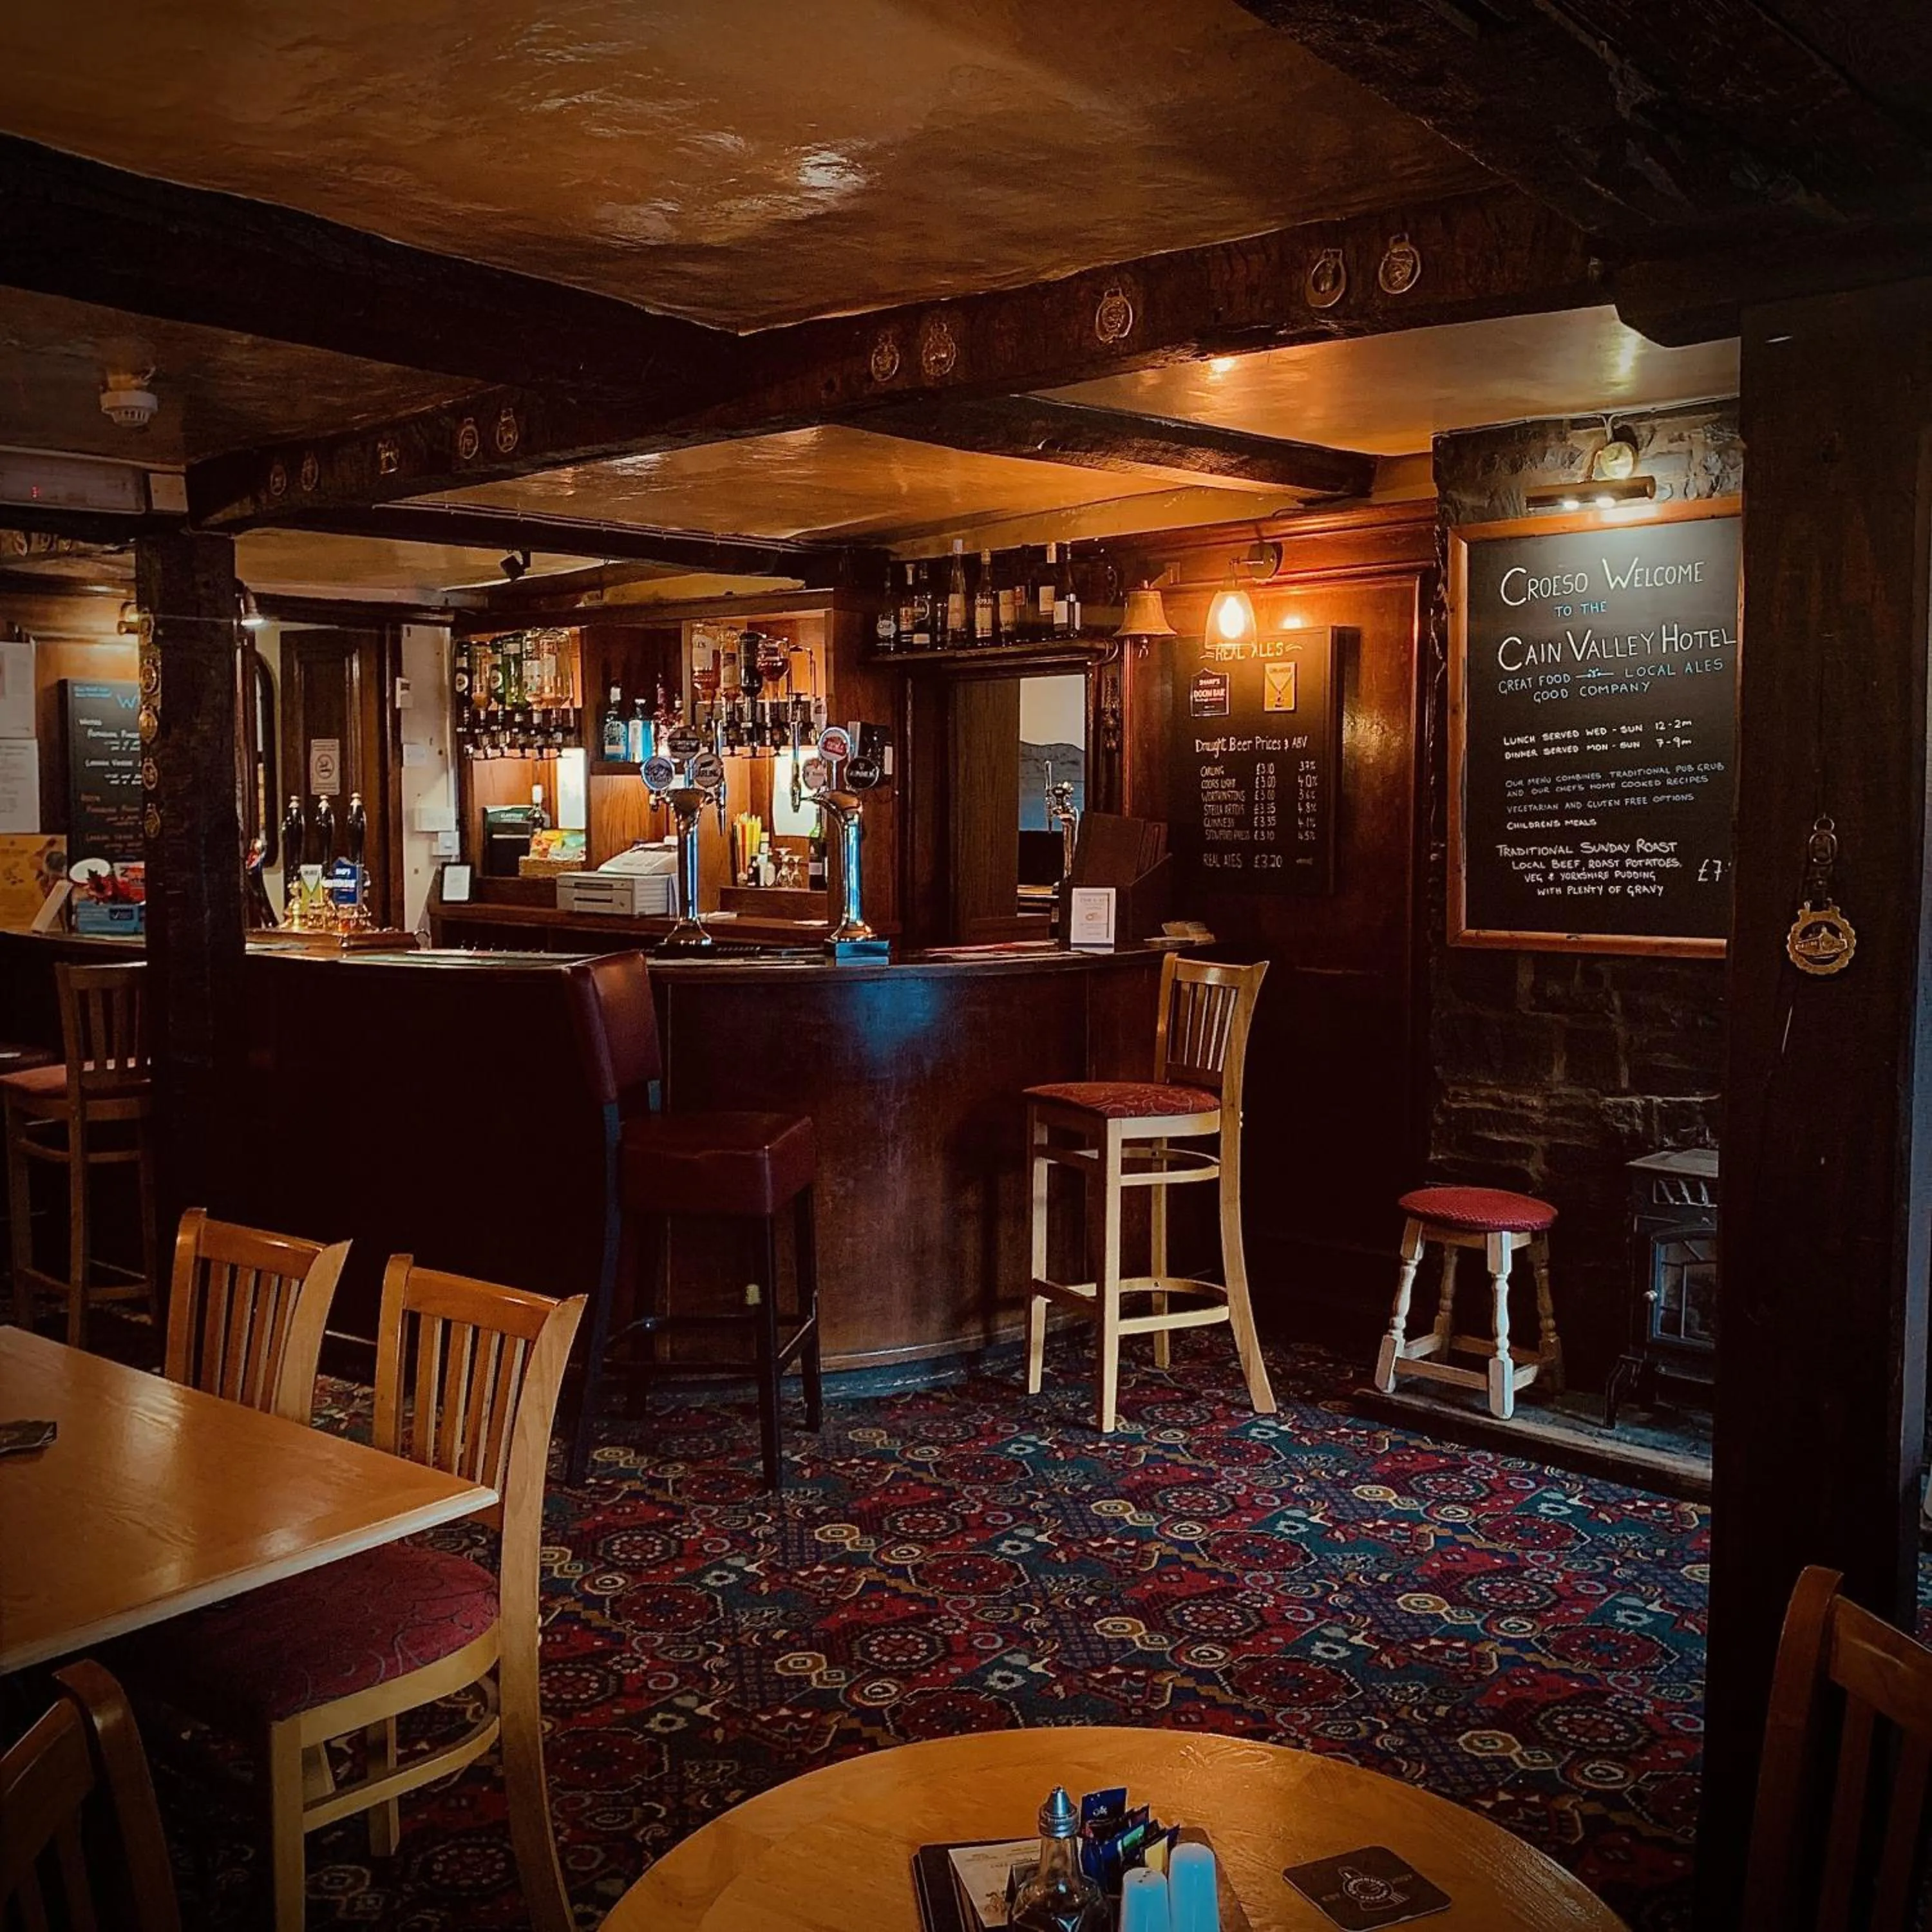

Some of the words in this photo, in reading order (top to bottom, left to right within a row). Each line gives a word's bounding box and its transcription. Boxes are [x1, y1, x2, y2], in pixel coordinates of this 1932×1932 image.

[1501, 567, 1588, 606] CROESO
[1602, 557, 1704, 590] WELCOME
[1555, 606, 1572, 618] TO
[1581, 601, 1607, 615] THE
[1251, 641, 1283, 658] ALES
[1498, 636, 1562, 671] CAIN
[1566, 629, 1654, 661] VALLEY
[1662, 623, 1736, 654] HOTEL
[1499, 677, 1533, 695] GREAT
[1539, 673, 1571, 687] FOOD
[1625, 664, 1676, 677] LOCAL
[1685, 658, 1723, 673] ALES
[1533, 688, 1568, 703] GOOD
[1580, 681, 1651, 697] COMPANY
[1229, 737, 1253, 752] Beer
[1255, 736, 1281, 751] Prices
[1292, 735, 1308, 748] ABV
[1503, 735, 1535, 746] LUNCH
[1542, 730, 1579, 741] SERVED
[1586, 727, 1607, 736] WED
[1620, 724, 1642, 734] SUN
[1504, 749, 1538, 759] DINNER
[1543, 745, 1578, 755] SERVED
[1505, 779, 1524, 788] OUR
[1528, 776, 1551, 786] MENU
[1555, 772, 1601, 782] COMBINES
[1610, 767, 1671, 779] TRADITIONAL
[1676, 764, 1694, 773] PUB
[1697, 762, 1725, 772] GRUB
[1506, 789, 1524, 797] AND
[1531, 786, 1550, 795] OUR
[1590, 782, 1616, 790] HOME
[1621, 780, 1662, 788] COOKED
[1666, 775, 1709, 786] RECIPES
[1506, 803, 1558, 813] VEGETARIAN
[1564, 801, 1582, 810] AND
[1586, 799, 1620, 809] GLUTEN
[1625, 797, 1648, 806] FREE
[1653, 793, 1694, 803] OPTIONS
[1564, 819, 1597, 827] MEALS
[1495, 844, 1574, 857] TRADITIONAL
[1580, 841, 1630, 854] SUNDAY
[1636, 838, 1678, 853] ROAST
[1511, 861, 1546, 870] LOCAL
[1588, 858, 1620, 868] ROAST
[1524, 873, 1543, 883] VEG
[1560, 870, 1609, 881] YORKSHIRE
[1615, 871, 1656, 881] PUDDING
[1537, 887, 1562, 896] WITH
[1567, 885, 1603, 896] PLENTY
[1608, 886, 1622, 894] OF
[1627, 885, 1663, 896] GRAVY
